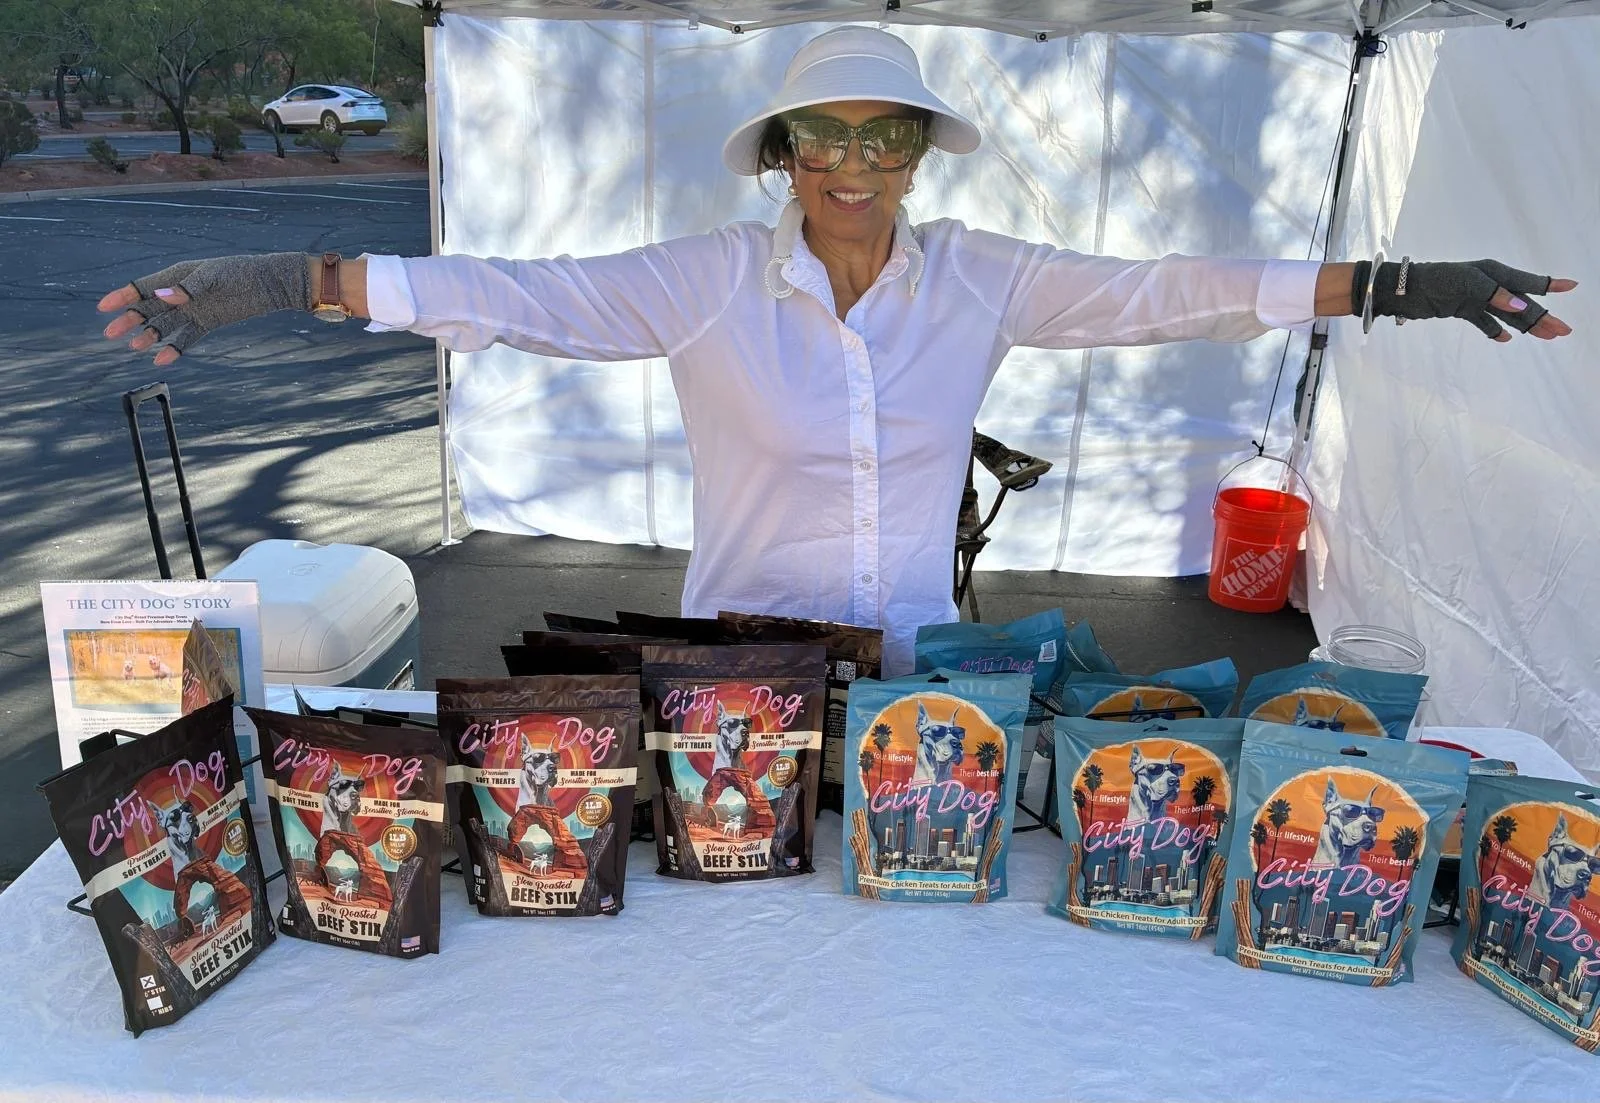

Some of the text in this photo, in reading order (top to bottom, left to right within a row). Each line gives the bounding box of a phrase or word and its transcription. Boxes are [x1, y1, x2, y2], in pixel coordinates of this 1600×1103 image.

[1230, 548, 1258, 568] THE
[1221, 547, 1285, 595] HOME
[66, 598, 97, 610] THE
[101, 598, 136, 610] CITY
[183, 598, 232, 609] STORY
[660, 686, 716, 725] City
[750, 685, 804, 728] Dog
[458, 716, 616, 764] City Dog
[750, 740, 778, 750] Sensitive
[273, 738, 330, 782] City
[362, 754, 422, 794] Dog
[888, 753, 913, 763] lifestyle
[476, 776, 516, 785] SOFT TREATS
[558, 776, 624, 786] Sensitive Stomachs
[960, 768, 975, 777] Their
[976, 770, 990, 778] best
[88, 750, 226, 857] City Dog
[282, 796, 319, 809] SOFT TREATS
[870, 777, 998, 829] City Dog
[1099, 795, 1126, 805] lifestyle
[362, 806, 429, 818] Sensitive Stomachs
[1174, 806, 1190, 814] Their
[1083, 818, 1146, 861] City
[1150, 817, 1211, 864] Dog
[1265, 827, 1315, 844] Your lifestyle
[127, 848, 158, 868] Premium
[702, 841, 761, 856] Slow Roasted
[1490, 840, 1532, 871] Your lifestyle
[122, 849, 167, 879] SOFT TREATS
[703, 852, 768, 868] BEEF STIX
[1368, 854, 1388, 864] Their
[1389, 857, 1406, 866] best
[512, 875, 573, 894] Slow Roasted
[860, 876, 890, 887] Premium
[1257, 857, 1411, 917] City Dog
[511, 887, 578, 905] BEEF STIX
[1482, 874, 1546, 934] City
[317, 901, 378, 921] Slow Roasted
[1068, 906, 1099, 917] Premium
[1101, 912, 1129, 920] Chicken
[1188, 918, 1208, 926] Dogs
[1578, 904, 1597, 919] Their
[318, 913, 381, 937] BEEF STIX
[1148, 925, 1166, 933] (454g)
[190, 920, 243, 969] Slow Roasted
[191, 928, 253, 985] BEEF STIX
[1239, 946, 1391, 977] Premium Chicken Treats for Adult Dogs
[1326, 971, 1345, 980] (454g)
[151, 986, 166, 996] STIX
[1488, 971, 1516, 993] Chicken
[1517, 991, 1538, 1009] Treats
[1539, 1006, 1550, 1016] for
[1550, 1014, 1572, 1031] Adult
[1572, 1026, 1596, 1040] Dogs
